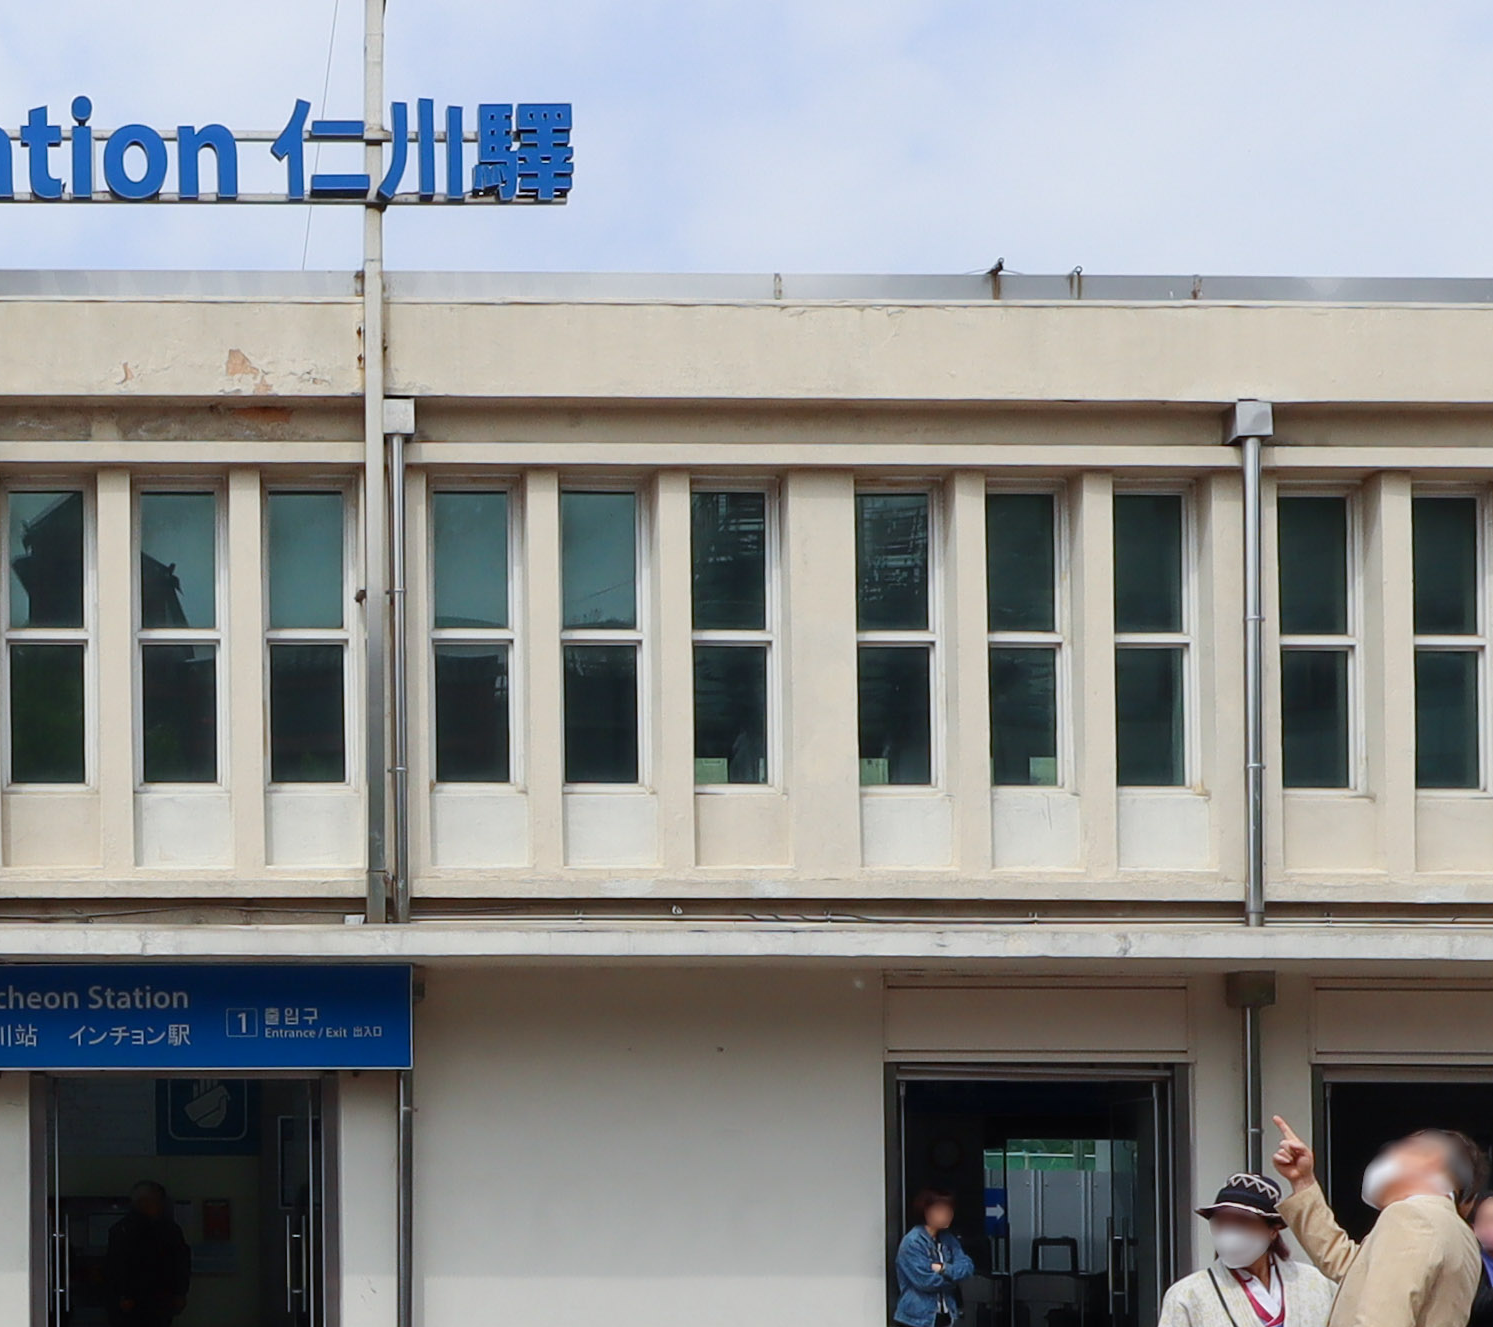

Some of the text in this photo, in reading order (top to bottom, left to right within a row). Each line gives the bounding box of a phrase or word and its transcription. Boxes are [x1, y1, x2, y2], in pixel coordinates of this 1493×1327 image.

[270, 98, 573, 202] 仁川驛
[88, 985, 190, 1010] Station
[237, 1012, 248, 1034] 1
[264, 1007, 320, 1026] 출입구
[68, 1023, 192, 1048] インチョン駅
[264, 1026, 317, 1039] Entrance
[326, 1026, 348, 1039] Exit
[353, 1026, 383, 1039] 出入口
